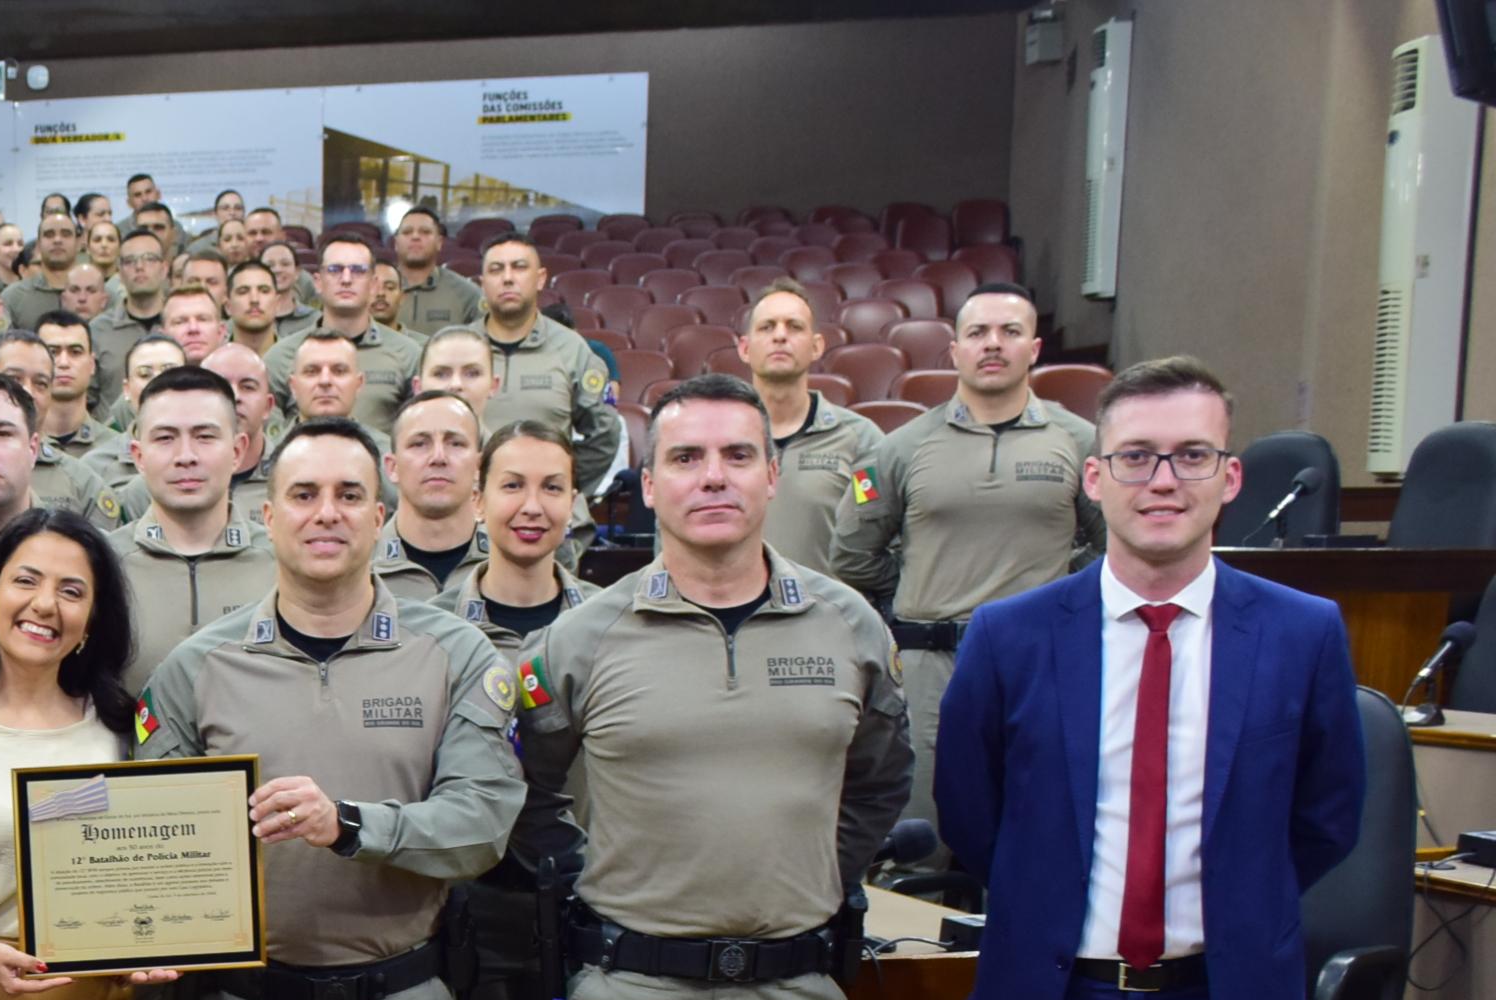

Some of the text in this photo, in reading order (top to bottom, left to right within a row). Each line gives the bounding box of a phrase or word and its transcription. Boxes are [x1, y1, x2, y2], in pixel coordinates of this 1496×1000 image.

[483, 91, 528, 102] FUNÇÕES
[483, 101, 563, 113] DAS COMISSÕES
[34, 123, 77, 134] FUNÇÕES
[767, 656, 834, 666] BRIGADA
[768, 666, 835, 676] MILITAR
[362, 696, 423, 708] BRIGADA
[363, 707, 423, 718] MILITAR
[81, 823, 197, 843] Homenagem
[89, 854, 130, 864] Batalhão
[132, 853, 145, 862] de
[181, 850, 212, 859] Militar
